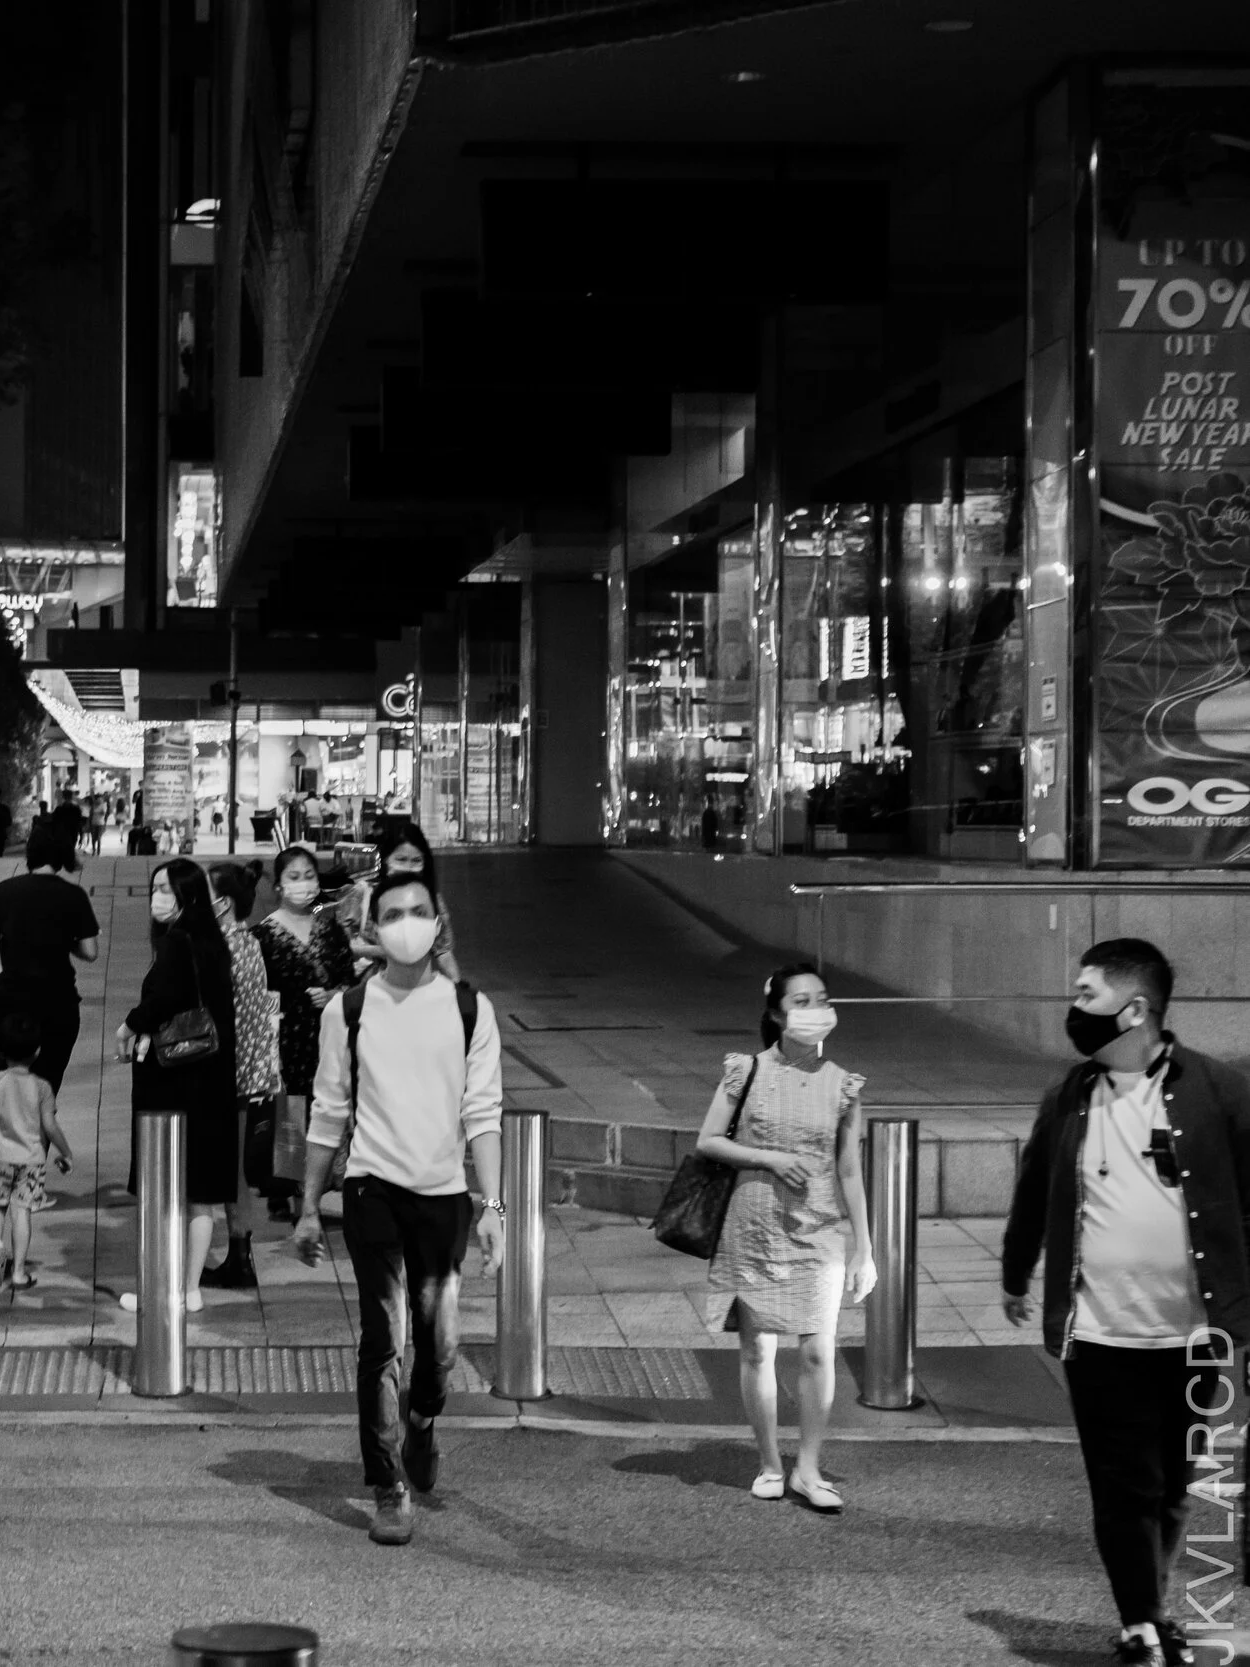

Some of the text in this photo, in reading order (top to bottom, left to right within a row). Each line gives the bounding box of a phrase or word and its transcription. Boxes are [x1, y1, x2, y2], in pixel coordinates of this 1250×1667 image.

[1139, 239, 1246, 267] UP TO
[1117, 278, 1250, 329] 70%
[1164, 335, 1217, 356] OFF
[1160, 371, 1236, 396] POST
[1142, 397, 1239, 421] LUNAR
[1120, 421, 1188, 446] NEW
[1158, 447, 1227, 471] SALE
[1127, 776, 1250, 816] OG
[1127, 815, 1203, 828] DEPARTMENT
